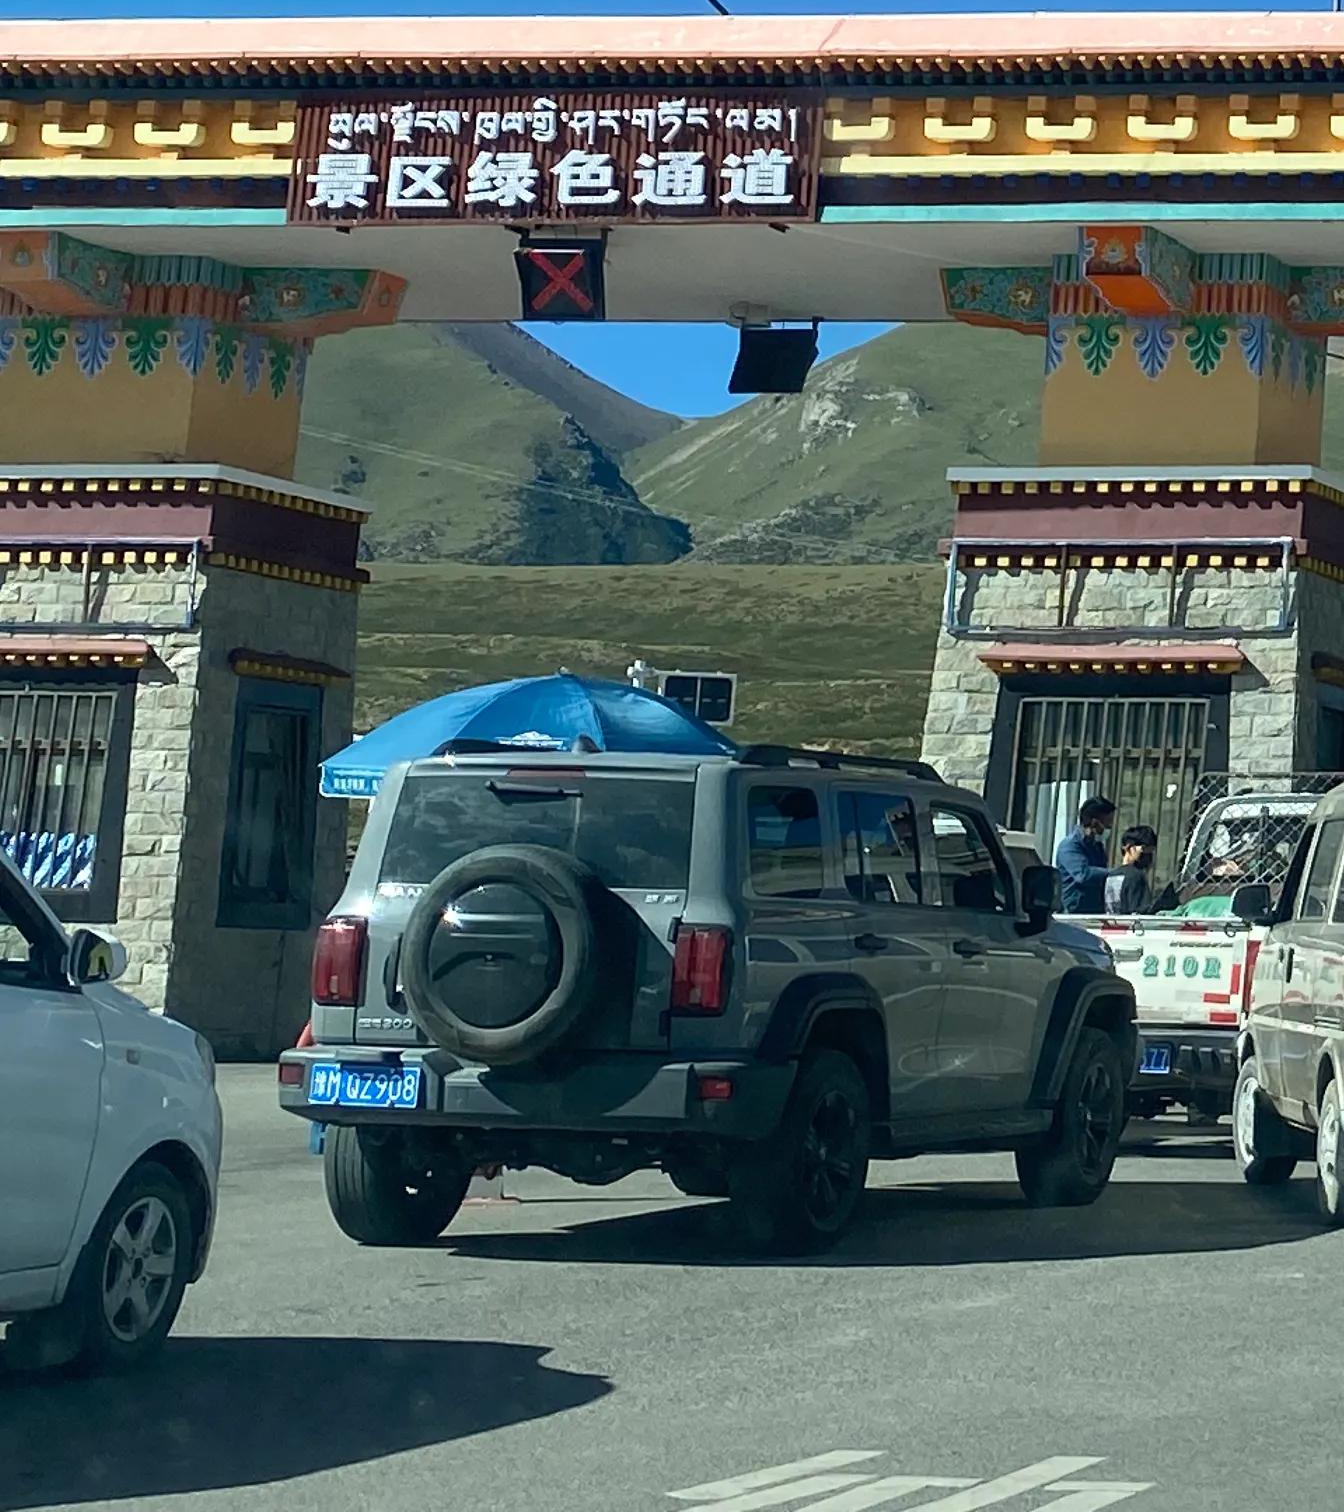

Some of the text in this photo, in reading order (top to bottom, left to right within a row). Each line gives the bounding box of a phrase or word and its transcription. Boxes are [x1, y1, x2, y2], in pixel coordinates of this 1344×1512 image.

[305, 148, 797, 208] 景区绿色通道
